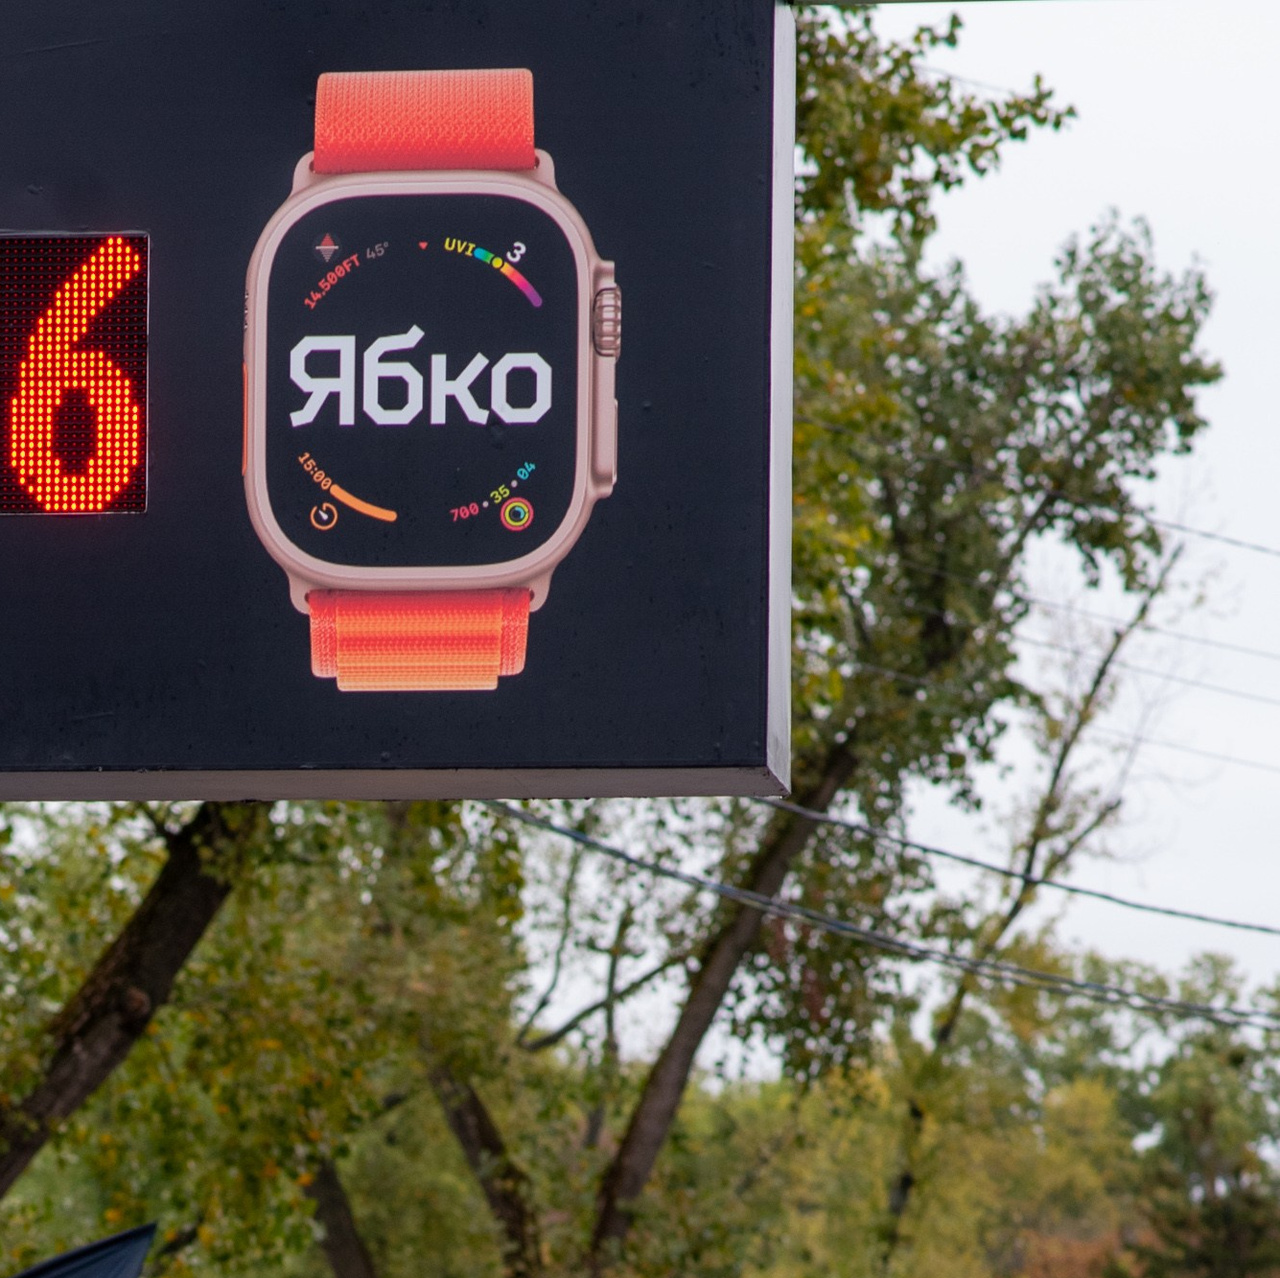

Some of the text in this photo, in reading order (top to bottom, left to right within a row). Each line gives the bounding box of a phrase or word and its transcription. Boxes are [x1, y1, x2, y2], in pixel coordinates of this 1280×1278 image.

[444, 237, 527, 263] UVI 3
[304, 253, 361, 309] 14,500FT
[289, 323, 553, 428] Ябко
[298, 452, 332, 490] 15:00
[450, 461, 536, 522] 700 35 04
